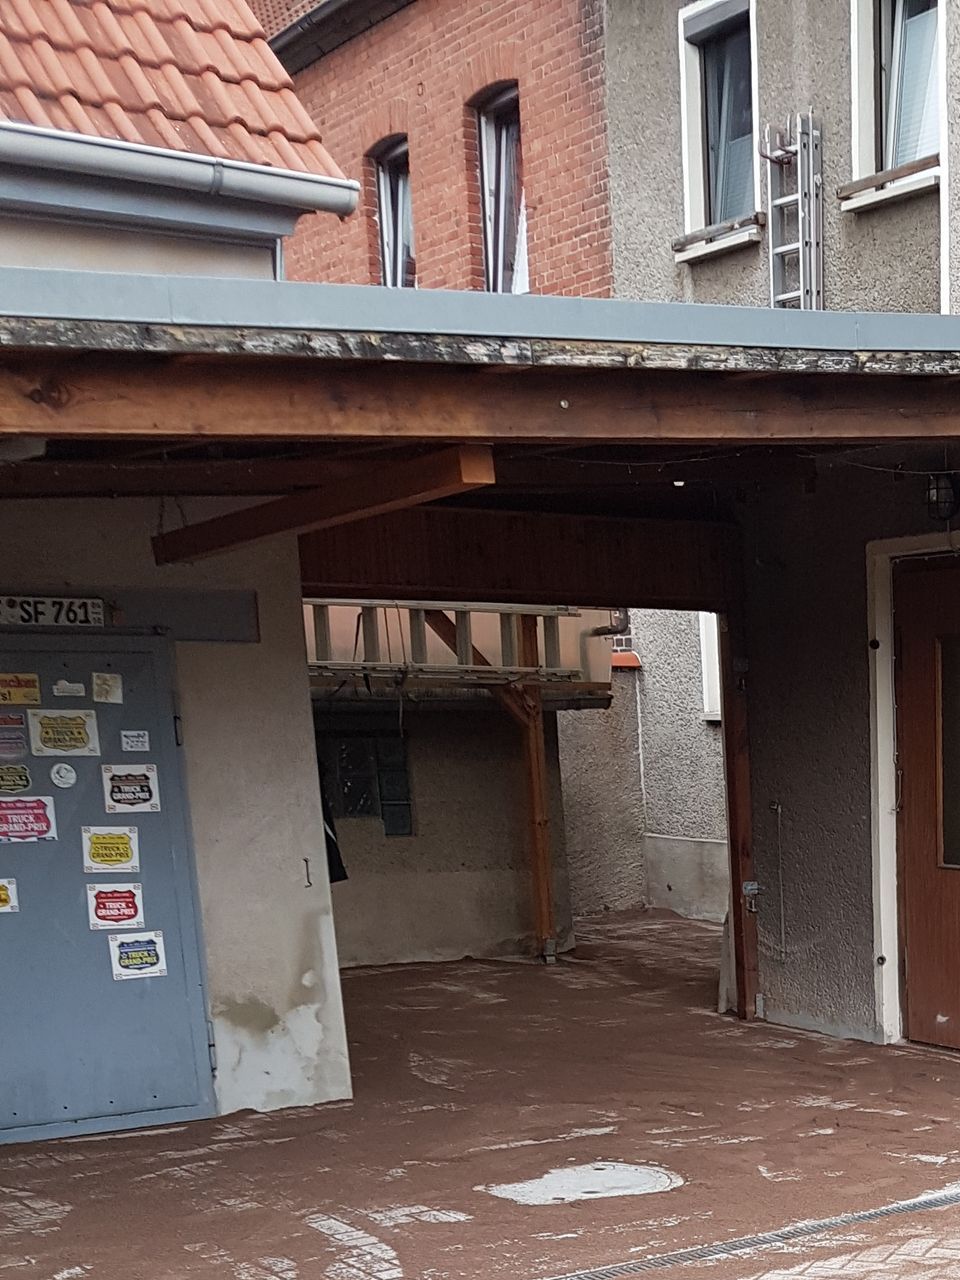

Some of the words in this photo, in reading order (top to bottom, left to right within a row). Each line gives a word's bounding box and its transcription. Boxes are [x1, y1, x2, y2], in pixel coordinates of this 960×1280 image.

[19, 600, 46, 624] SF
[52, 600, 91, 625] 761
[7, 815, 35, 823] TRUCK
[128, 951, 149, 959] TRUCK
